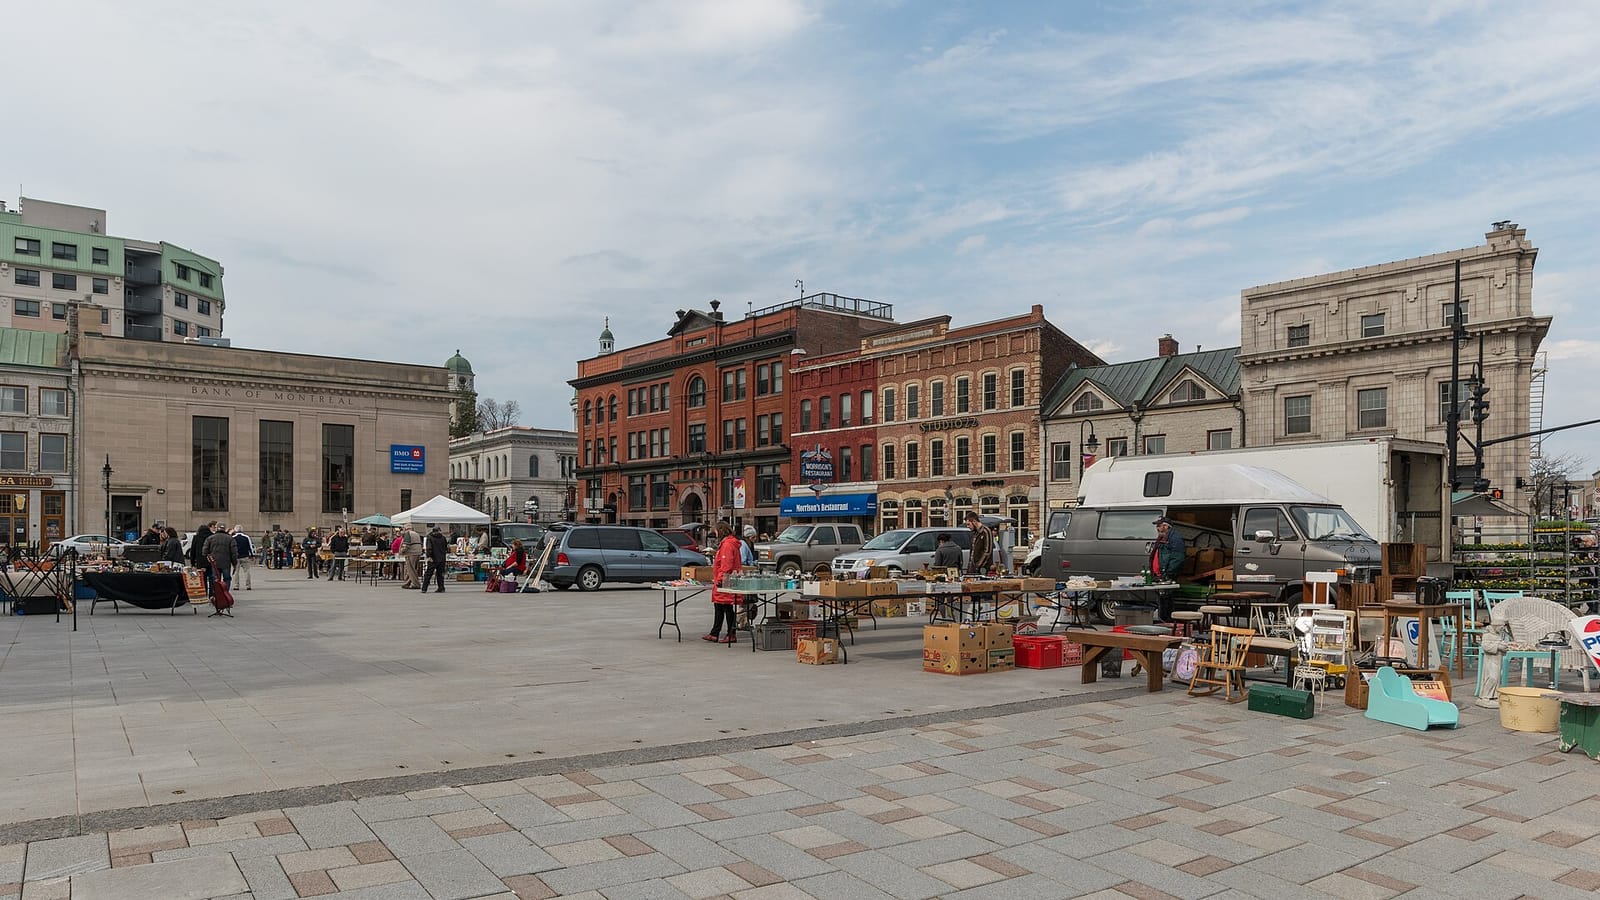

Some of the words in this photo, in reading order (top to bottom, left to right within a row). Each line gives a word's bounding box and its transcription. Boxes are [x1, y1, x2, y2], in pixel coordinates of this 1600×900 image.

[191, 386, 232, 397] BANK
[245, 390, 261, 399] OF
[274, 392, 353, 406] MONTREAL
[805, 463, 832, 471] MORRISON'S
[796, 503, 820, 513] Morrison's
[821, 502, 849, 511] Restaurant
[923, 649, 940, 659] Dole
